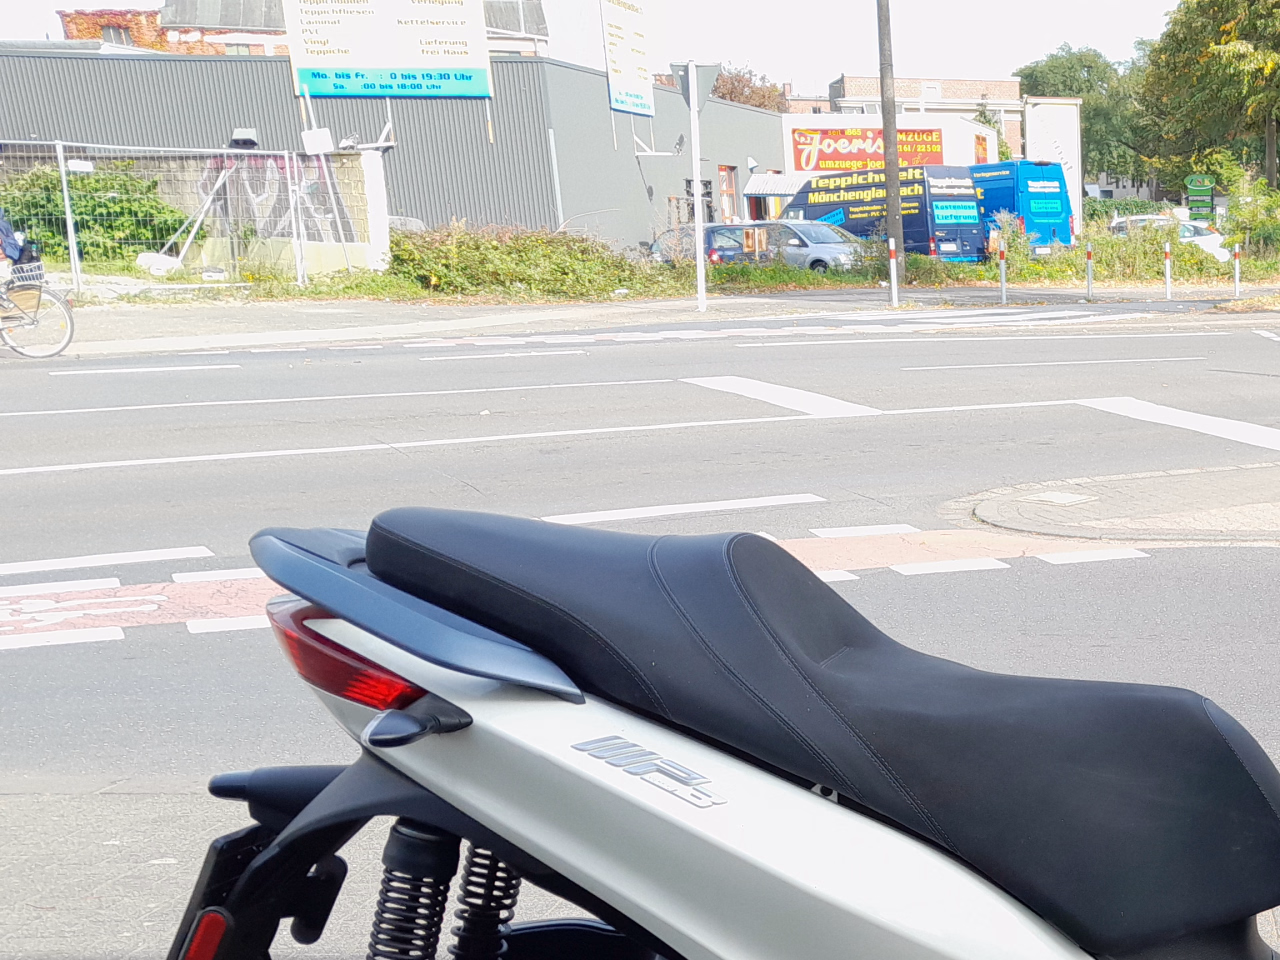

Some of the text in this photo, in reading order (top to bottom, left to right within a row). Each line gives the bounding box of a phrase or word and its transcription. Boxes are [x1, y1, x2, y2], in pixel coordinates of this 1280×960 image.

[299, 8, 375, 16] Teppichfliesen
[397, 18, 466, 26] Kettelservice
[303, 38, 329, 46] Vinyl
[419, 38, 468, 47] Lieferung
[305, 47, 350, 56] Teppiche
[311, 71, 331, 79] Mo.
[334, 71, 352, 79] bis
[400, 73, 418, 81] bis
[421, 72, 451, 81] 19:30
[454, 73, 474, 82] Uhr
[897, 129, 941, 142] MZÜGE
[934, 203, 975, 211] Kostenlose
[936, 213, 977, 222] Lieferung
